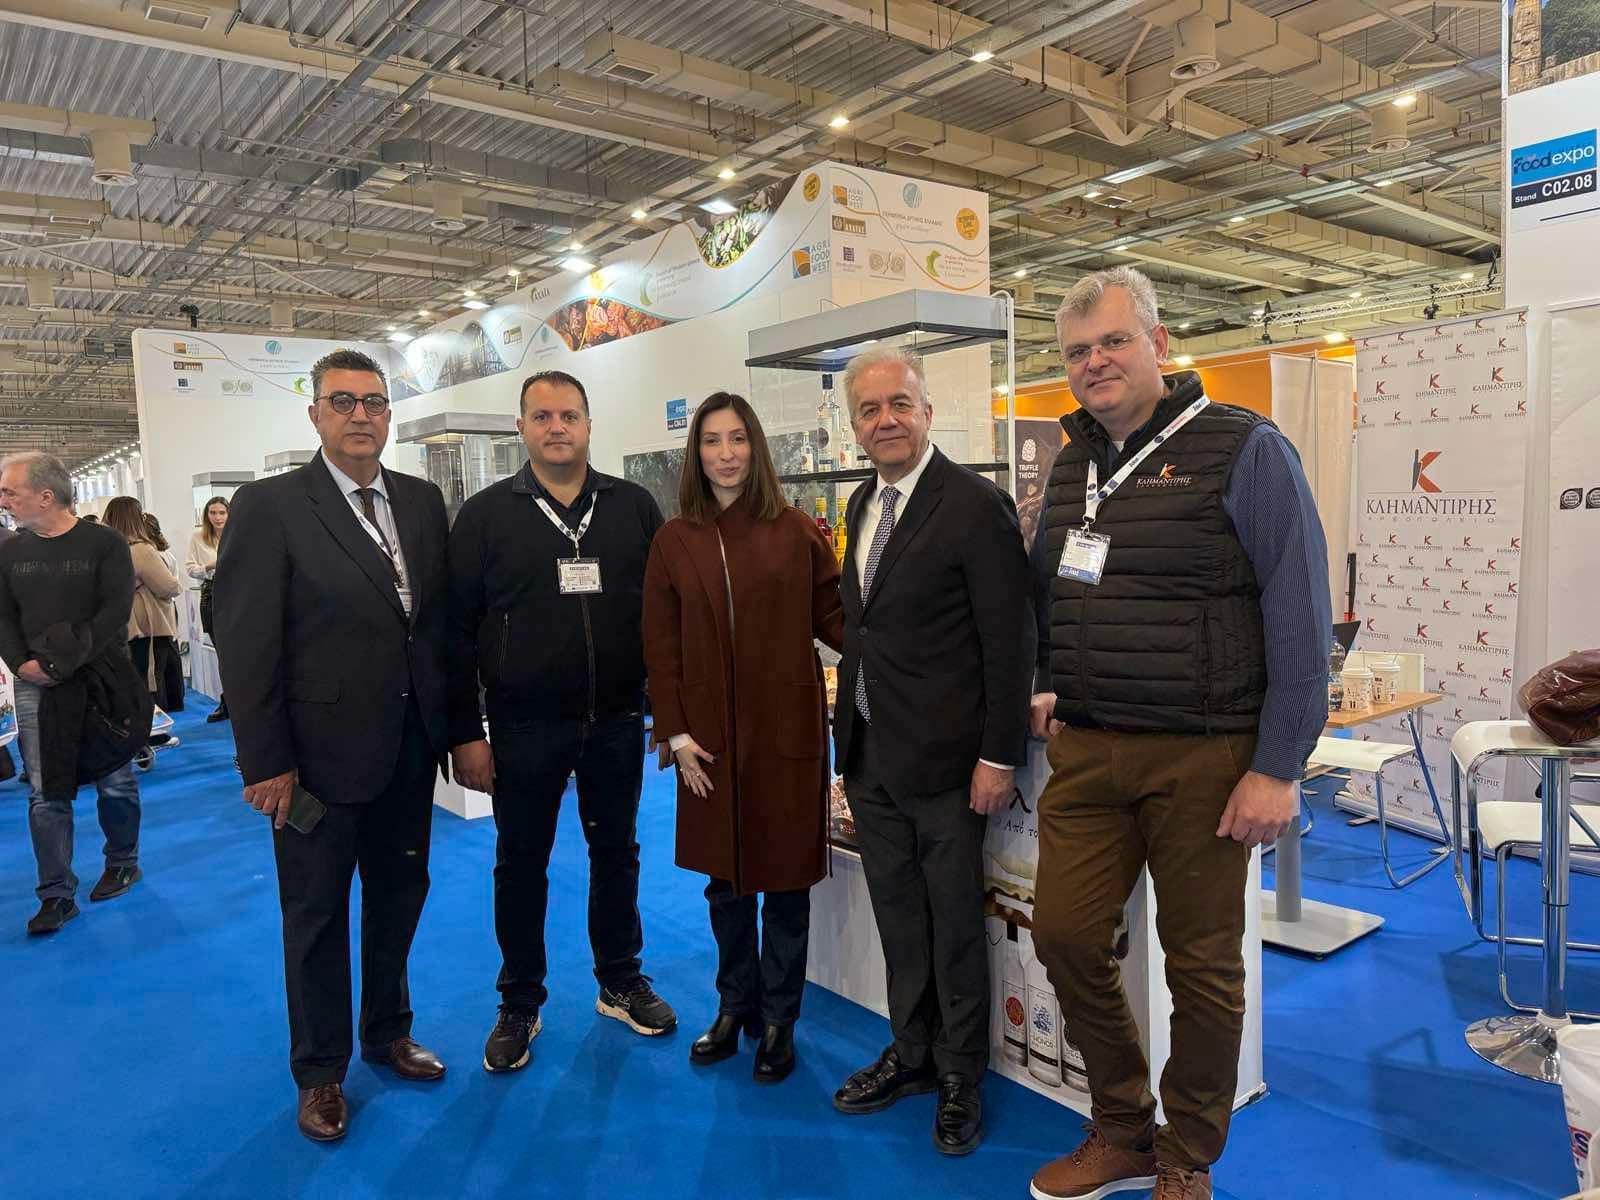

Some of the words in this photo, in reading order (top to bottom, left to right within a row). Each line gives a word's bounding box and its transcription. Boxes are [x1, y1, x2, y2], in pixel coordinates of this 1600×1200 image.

[1515, 192, 1537, 203] Stand
[1541, 174, 1593, 197] C02.08
[811, 240, 831, 252] AGRI
[811, 250, 831, 263] FOOD
[811, 260, 831, 273] WEST
[1367, 496, 1497, 515] ΚΛΗΜΑΝΤΙΡΗΣ
